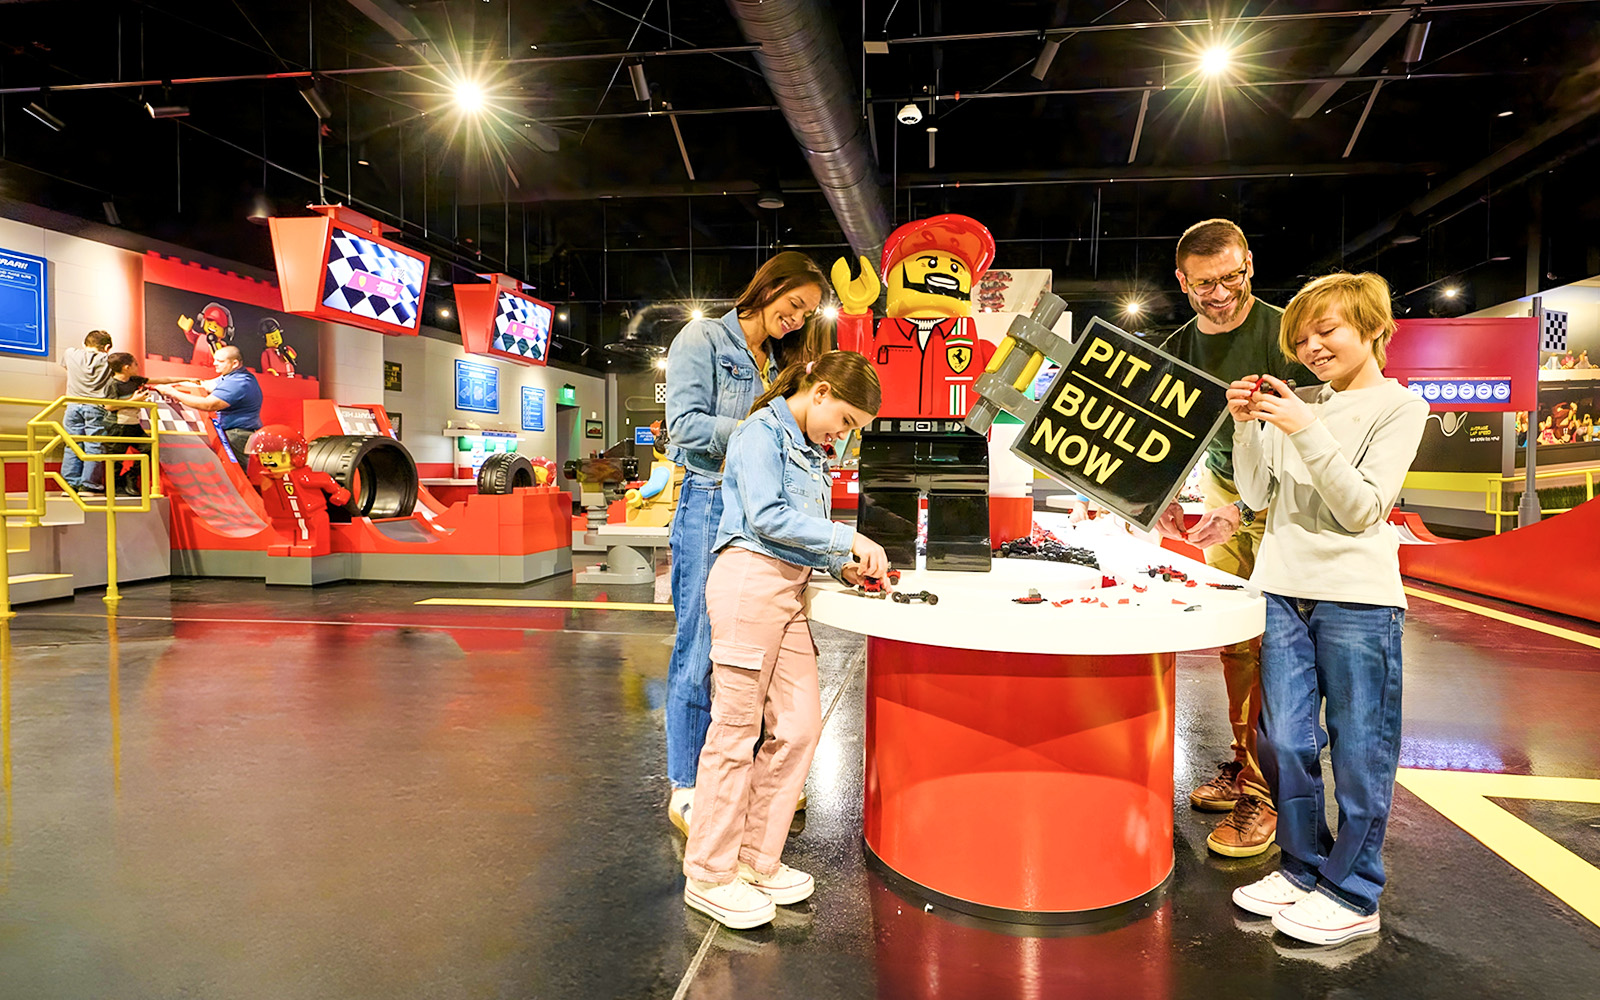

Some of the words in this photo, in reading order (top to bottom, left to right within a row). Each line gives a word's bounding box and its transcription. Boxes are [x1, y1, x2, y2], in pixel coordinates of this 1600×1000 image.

[1080, 336, 1152, 388] PIT
[1149, 372, 1202, 419] IN
[1030, 417, 1123, 485] NOW
[1051, 382, 1172, 463] BUILD
